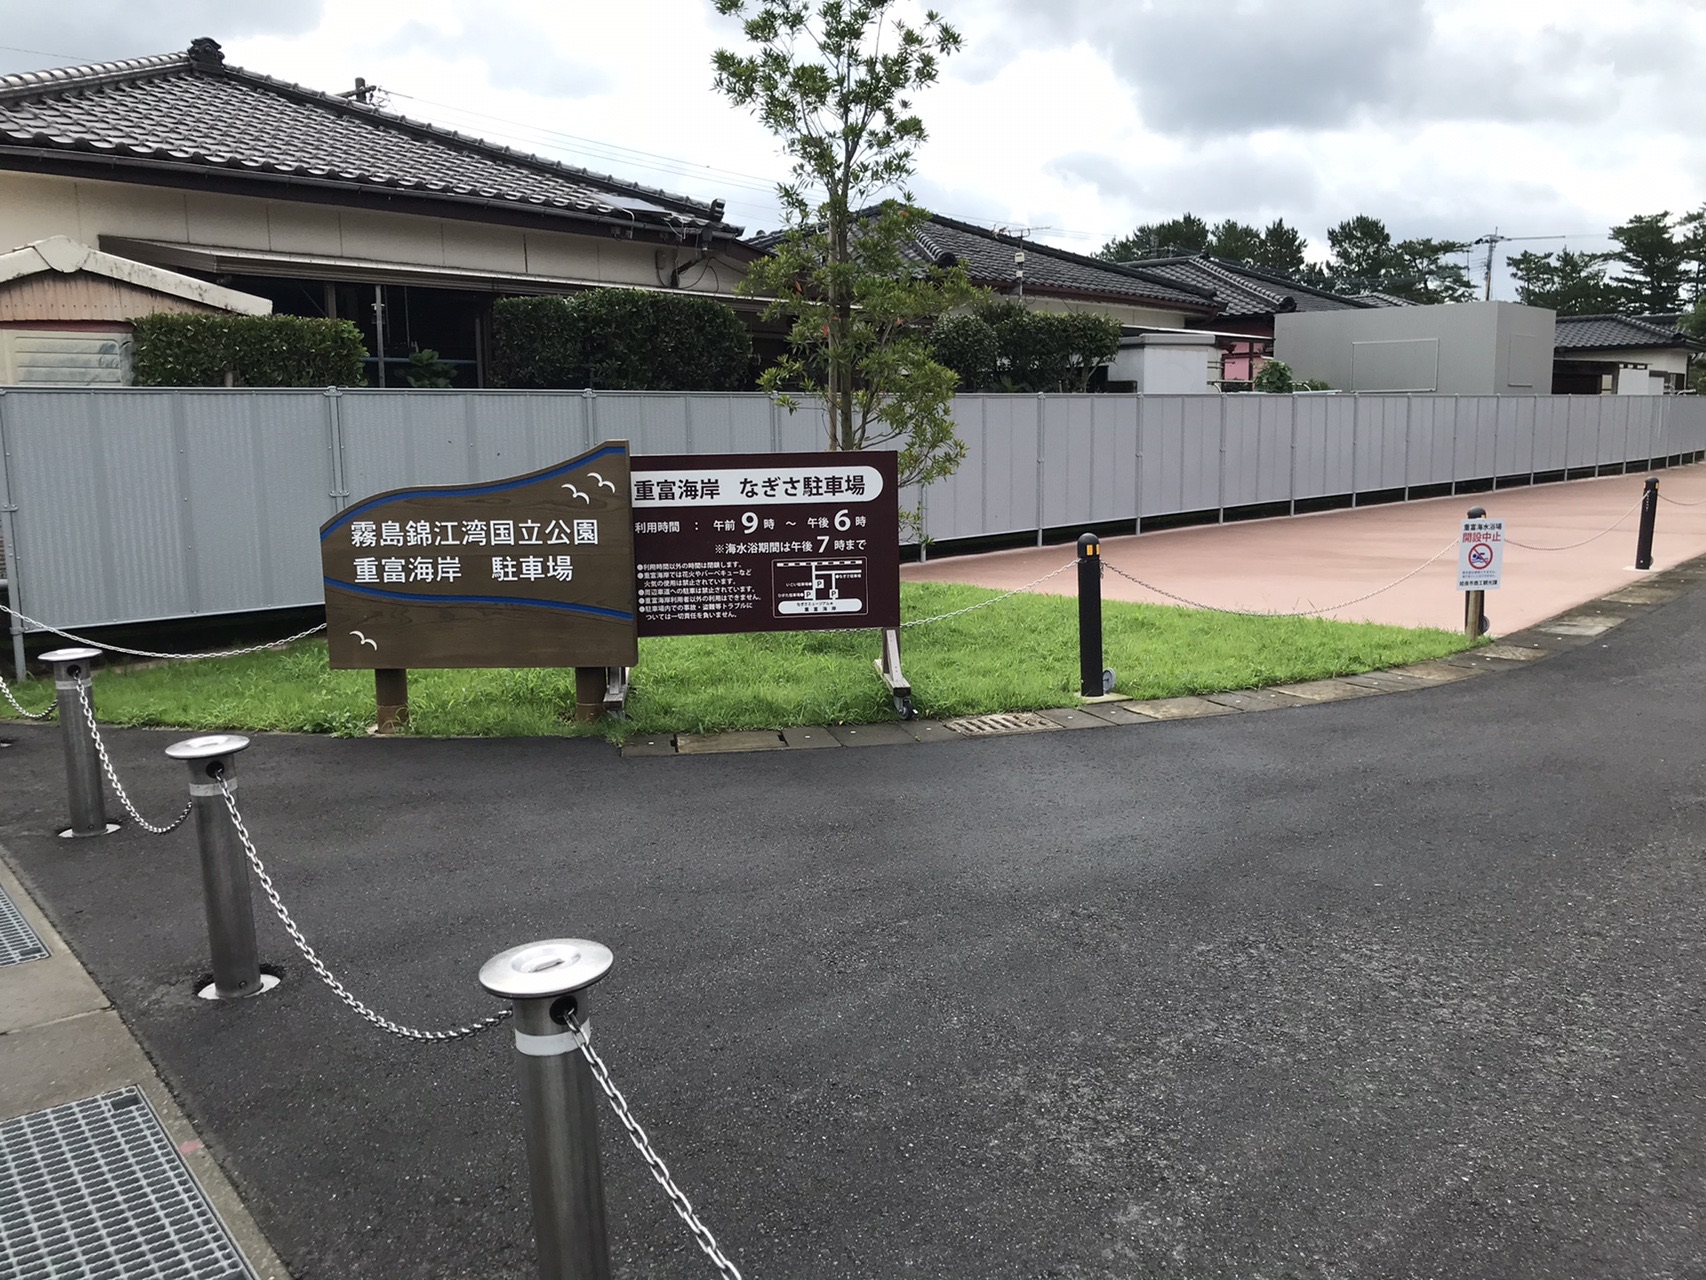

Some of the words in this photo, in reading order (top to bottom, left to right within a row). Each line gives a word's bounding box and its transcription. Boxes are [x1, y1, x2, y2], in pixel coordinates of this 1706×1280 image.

[634, 478, 720, 501] 重富海岸
[739, 474, 866, 498] なぎさ駐車場
[351, 519, 599, 548] 霧島錦江湾国立公園
[634, 520, 680, 534] 利用時間
[1462, 532, 1501, 543] 開設中止
[353, 556, 462, 583] 重富海岸
[491, 555, 574, 582] 駐車場
